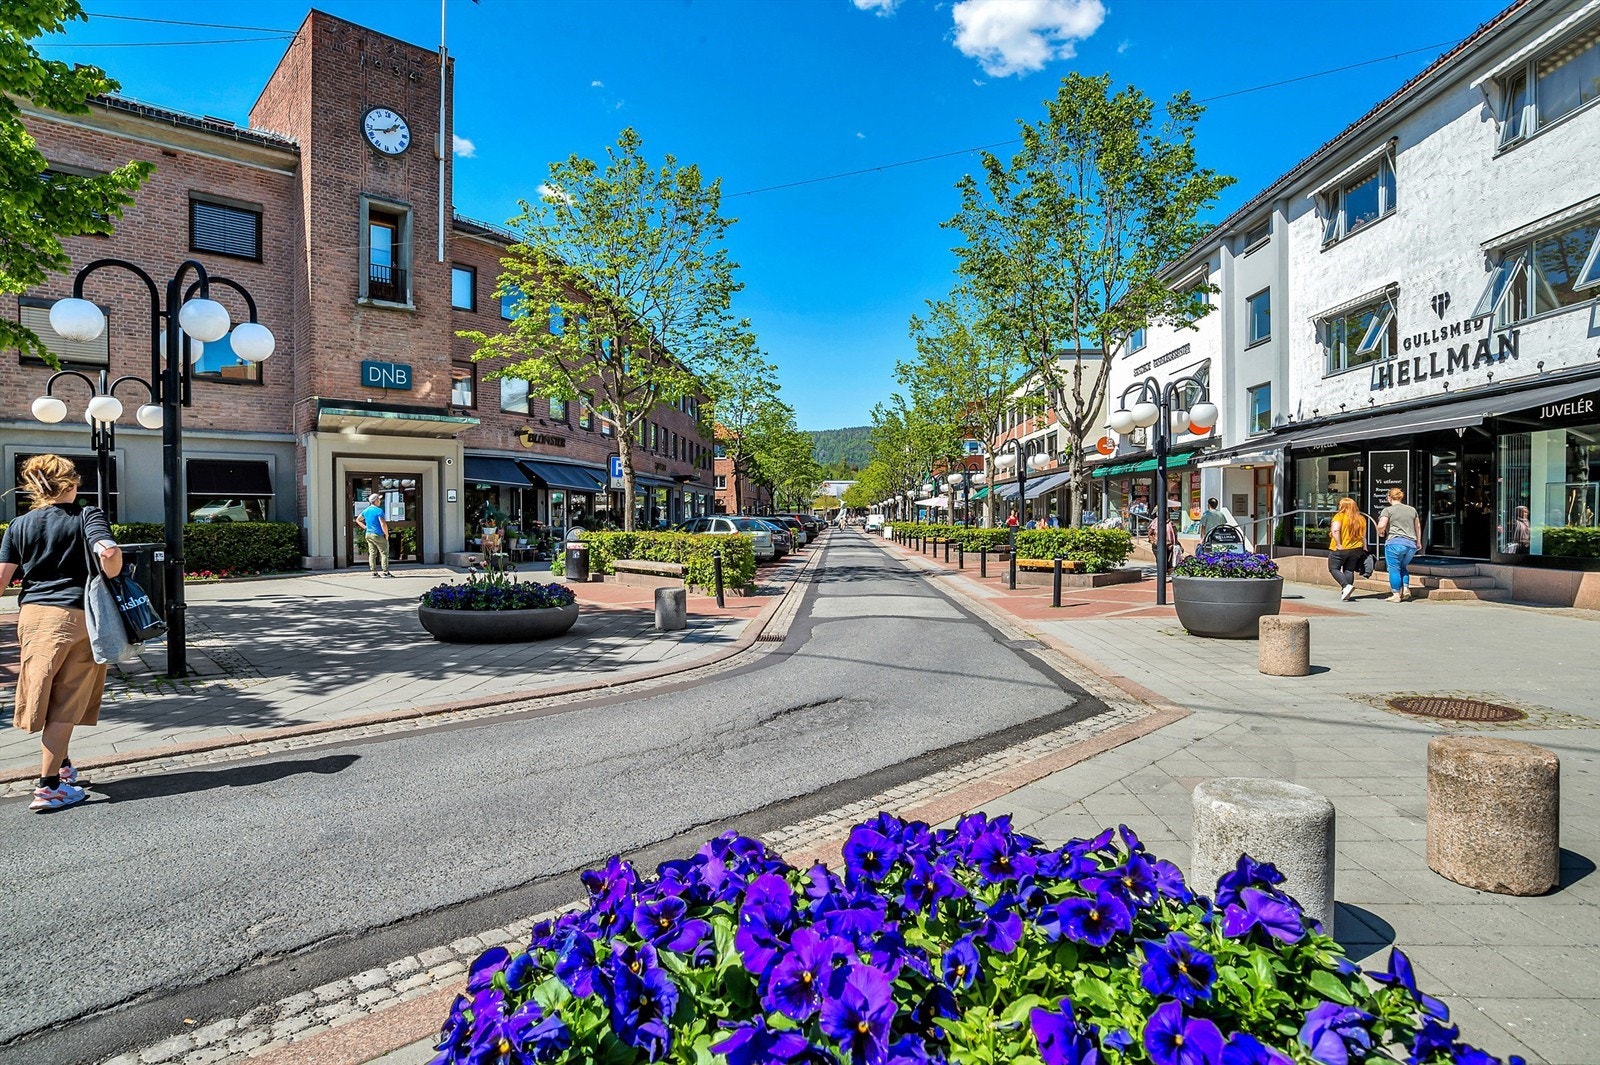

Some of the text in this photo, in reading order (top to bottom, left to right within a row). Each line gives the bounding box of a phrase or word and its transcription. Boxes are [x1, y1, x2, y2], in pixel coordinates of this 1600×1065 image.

[1402, 319, 1484, 351] GULLSMED
[1378, 329, 1520, 391] HELLMAN
[369, 363, 407, 388] DNB
[1540, 398, 1594, 419] JUVELÉR
[615, 460, 623, 476] P
